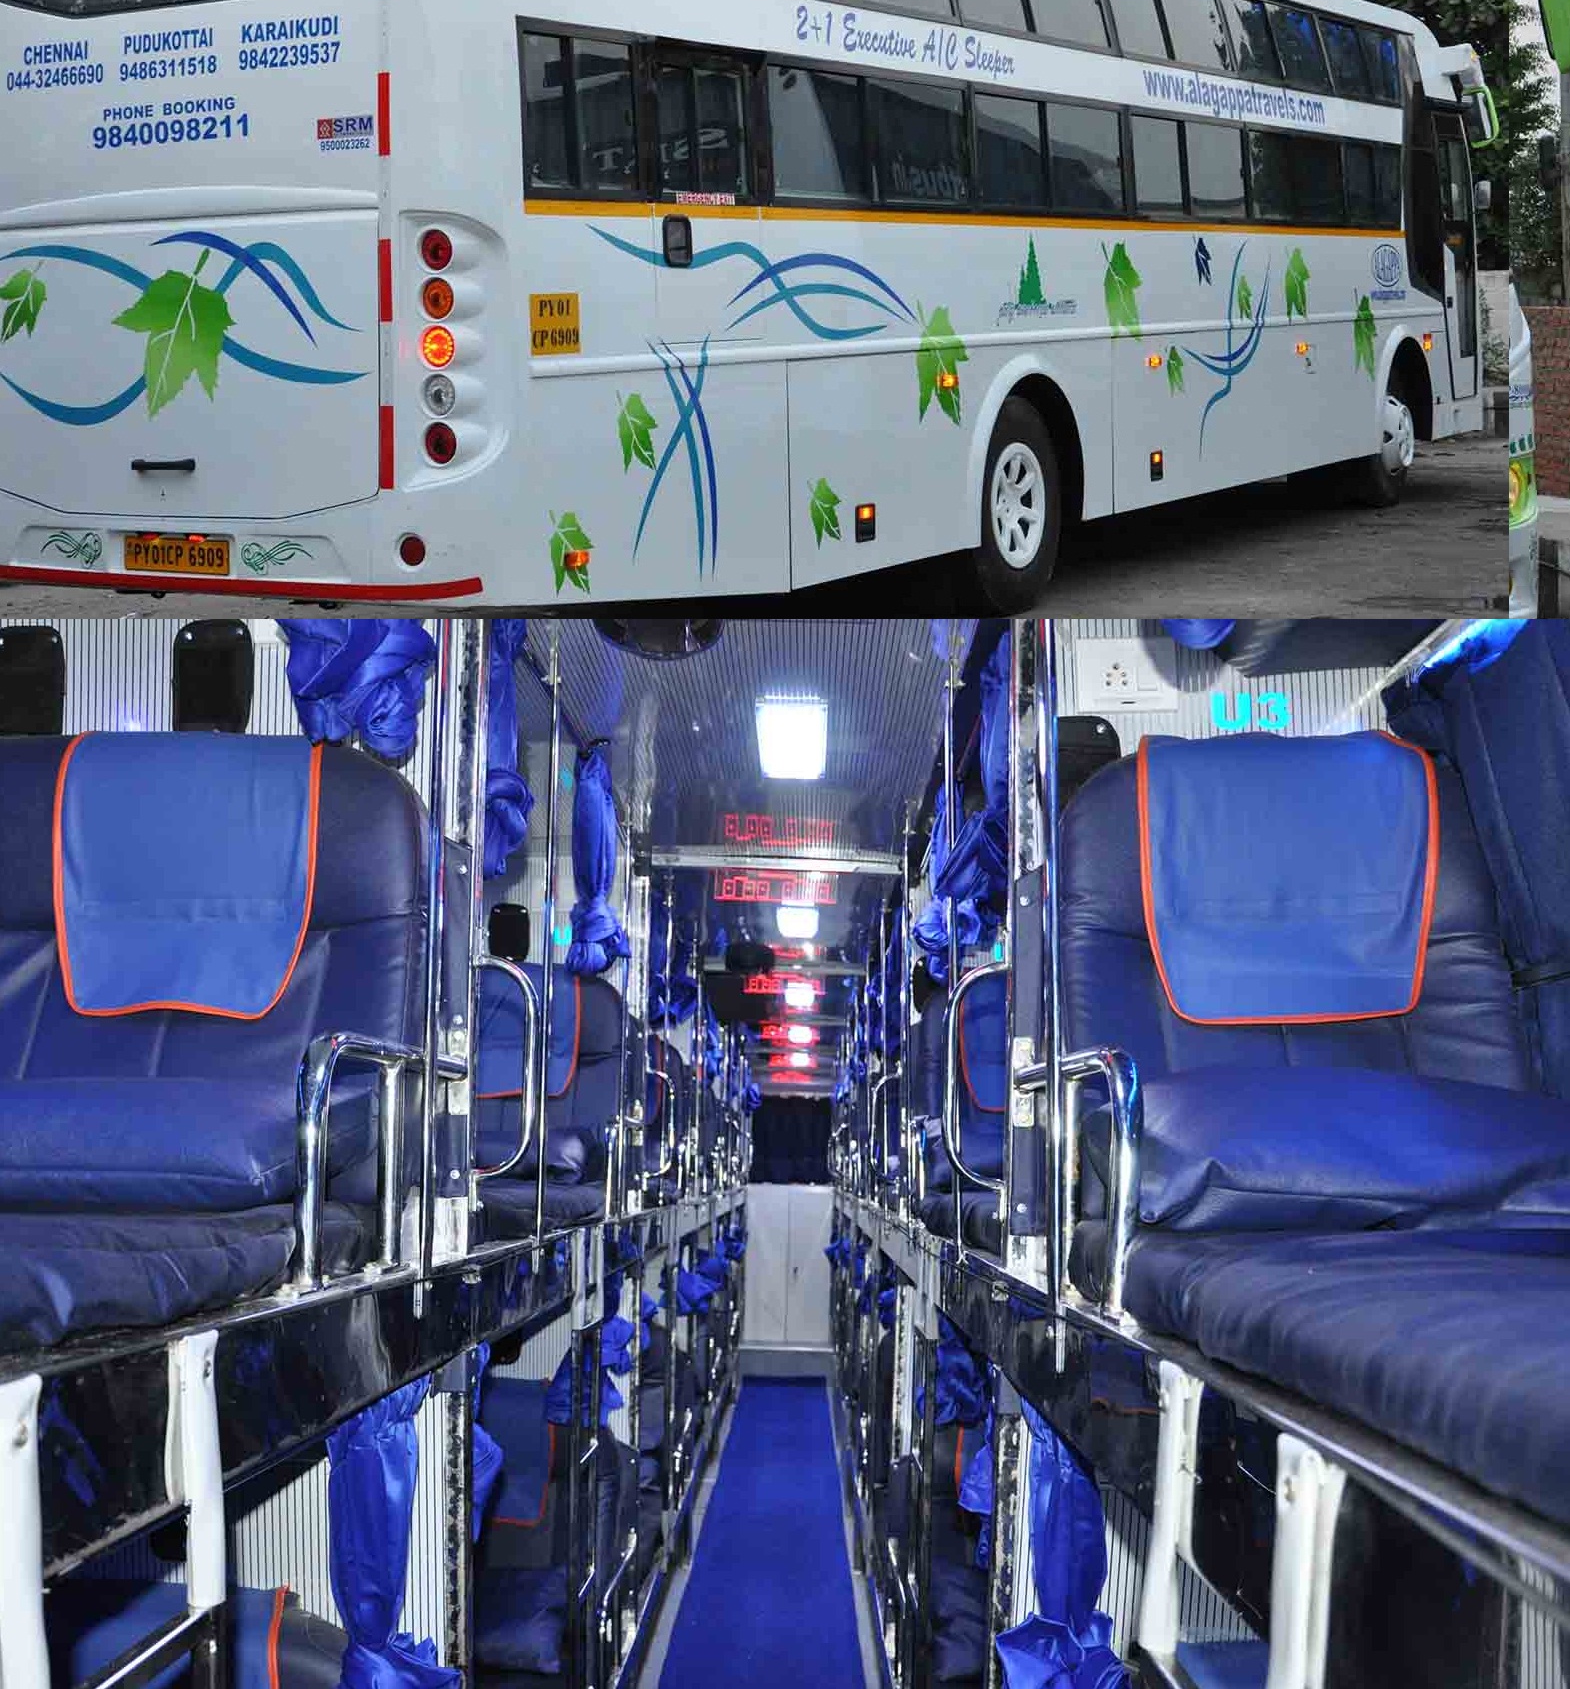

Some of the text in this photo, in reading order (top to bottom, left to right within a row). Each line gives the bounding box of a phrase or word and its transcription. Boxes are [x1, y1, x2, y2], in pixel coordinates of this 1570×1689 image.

[123, 27, 214, 55] PUDUKOTTAI
[241, 16, 339, 44] KARAIKUDI
[23, 41, 88, 65] CHENNAI
[238, 41, 341, 71] 9842239537
[842, 12, 917, 60] Executive
[964, 35, 1015, 79] Sleeper
[6, 63, 104, 91] 044-32466690
[119, 54, 218, 82] 9486311518
[103, 96, 236, 122] PHONE BOOKING
[1143, 69, 1325, 127] www.alagappatravels.com
[92, 113, 250, 150] 9840098211
[333, 116, 373, 133] SRM
[320, 138, 370, 151] 9500023262
[134, 543, 224, 567] PY01CP 6909
[1213, 691, 1290, 730] U3
